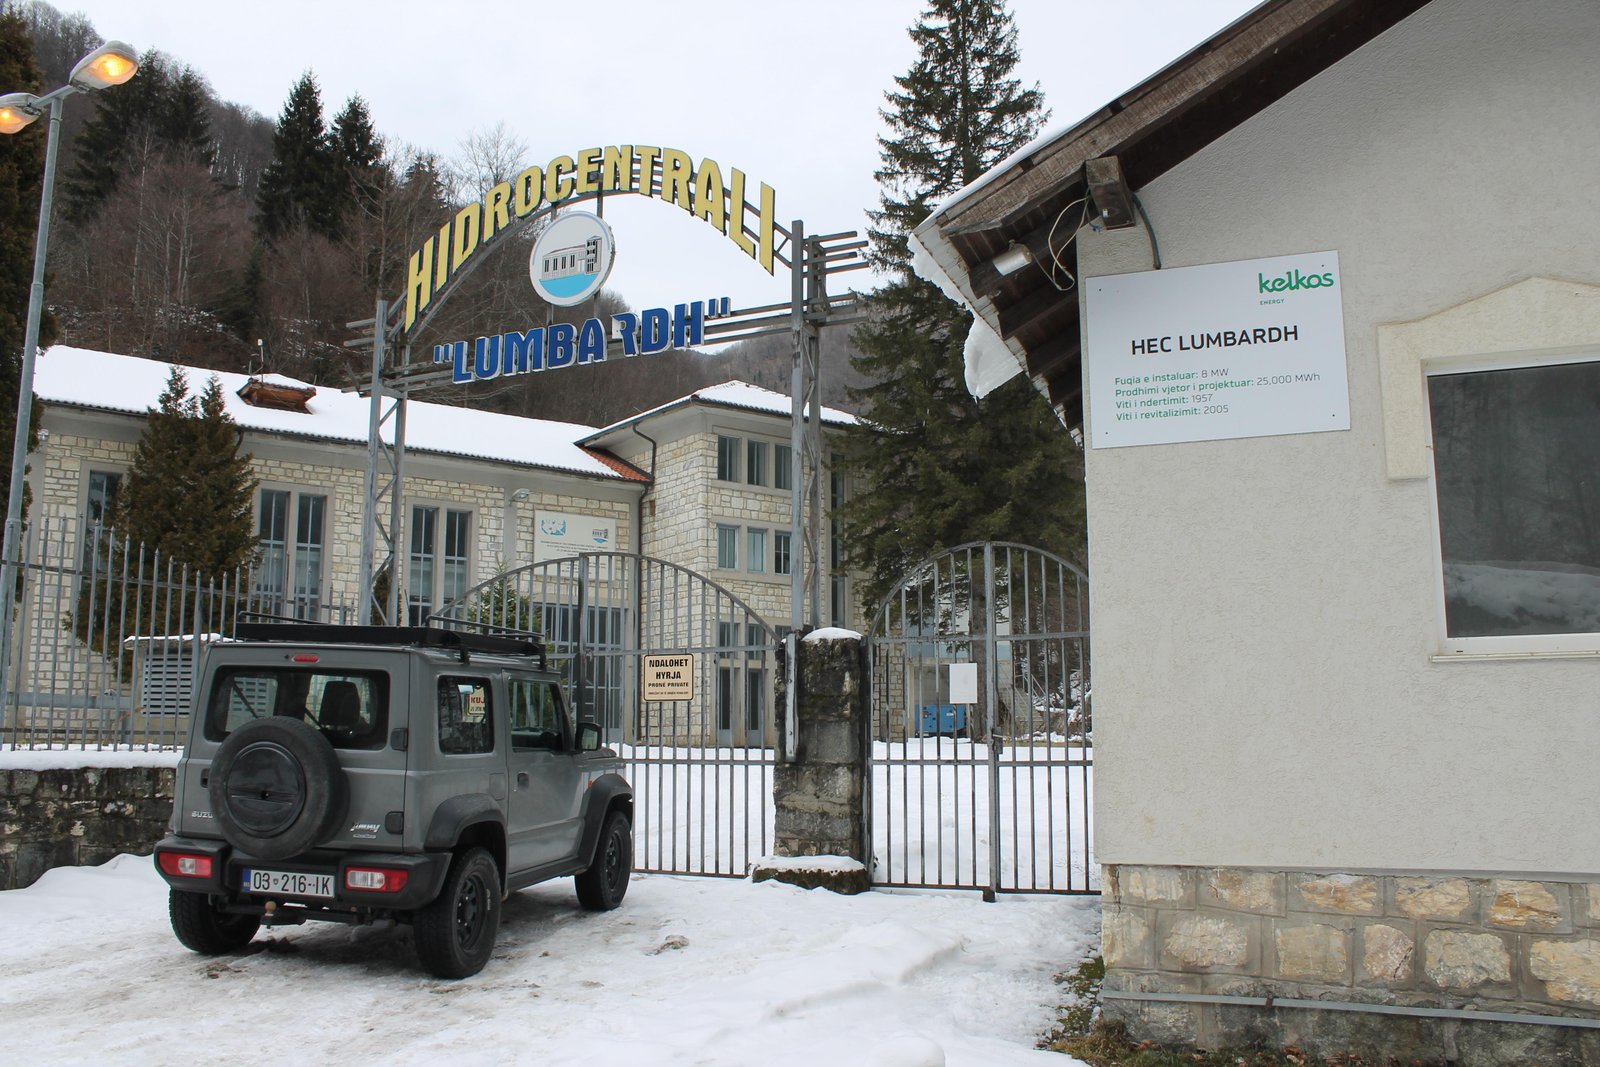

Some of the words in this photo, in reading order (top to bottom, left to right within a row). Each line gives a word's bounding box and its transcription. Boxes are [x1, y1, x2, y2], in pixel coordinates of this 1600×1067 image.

[405, 145, 776, 332] HIDROCENTRALI
[1258, 269, 1335, 293] kelkos
[1259, 298, 1285, 306] ENERGY
[1131, 336, 1172, 355] HEC
[1179, 325, 1298, 351] LUMBARDH
[1115, 375, 1141, 386] Fuqia
[1152, 371, 1199, 382] instaluar:
[1201, 369, 1208, 378] 8
[1210, 368, 1229, 377] MW
[1115, 385, 1159, 397] Prodhimi
[1161, 384, 1190, 395] vjetor
[1198, 378, 1254, 392] projektuar:
[1295, 372, 1321, 382] MWh
[1115, 399, 1132, 409] Viti
[1191, 393, 1213, 403] 1957
[1116, 411, 1132, 421] Viti
[1140, 407, 1201, 419] revitalizimit:
[1203, 404, 1229, 415] 2005
[649, 658, 689, 668] NDALOHET
[656, 671, 681, 680] HYRJA
[191, 809, 213, 819] SUZU
